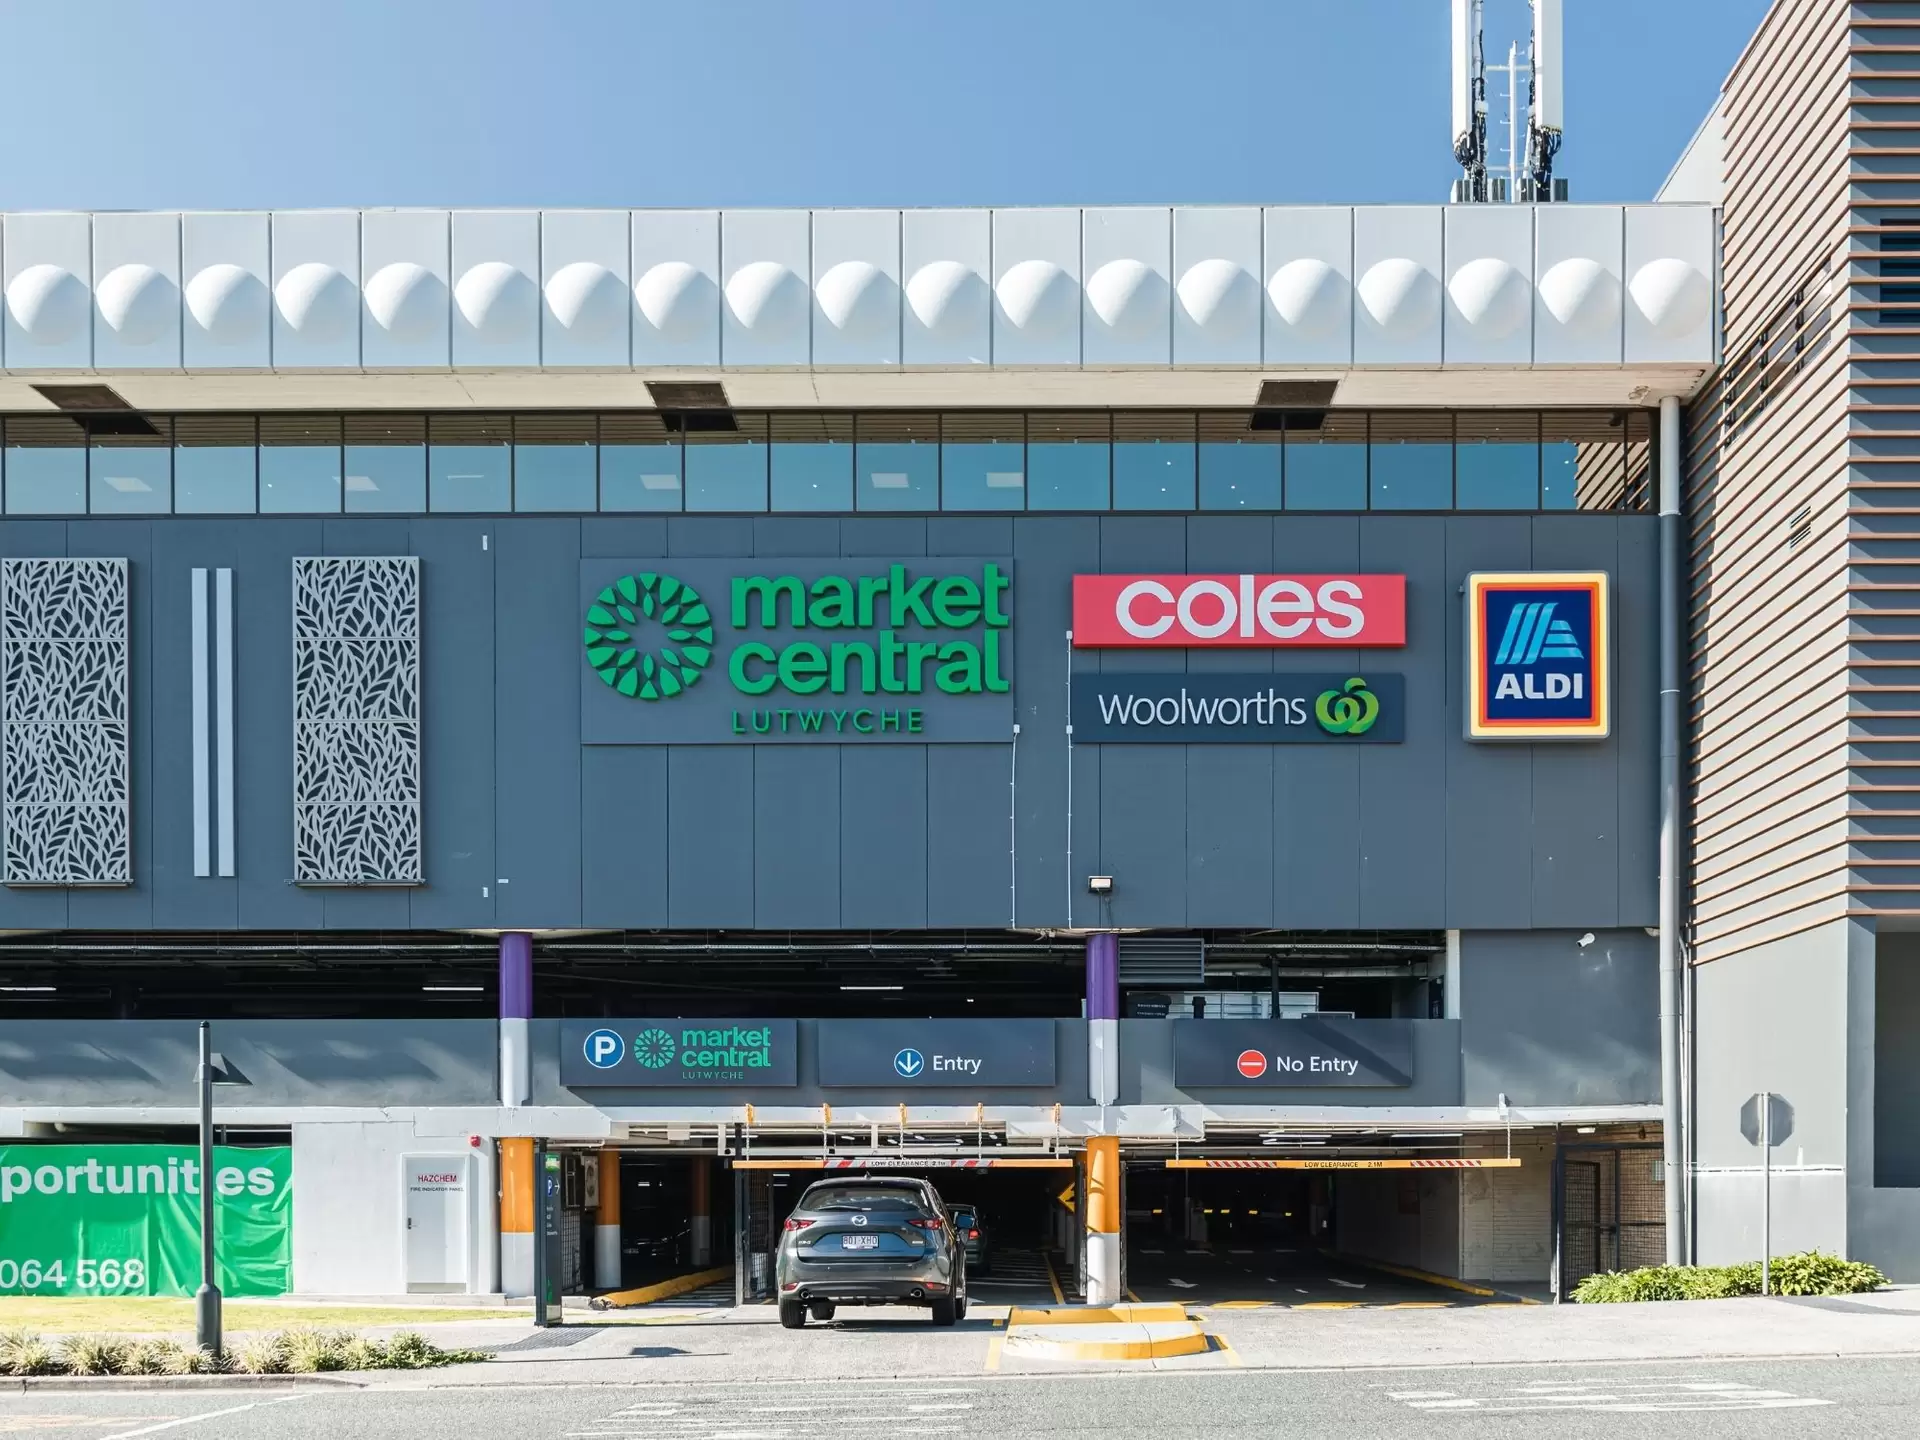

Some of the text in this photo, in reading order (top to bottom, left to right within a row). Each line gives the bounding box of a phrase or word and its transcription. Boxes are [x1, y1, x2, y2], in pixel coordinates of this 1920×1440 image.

[731, 563, 1010, 629] market
[1115, 574, 1365, 639] coles
[728, 629, 1010, 695] central
[1494, 673, 1584, 700] ALDI
[1098, 688, 1308, 725] Woolworths
[731, 709, 924, 735] LUTWYCHE
[595, 1036, 616, 1063] P
[681, 1026, 772, 1047] market
[680, 1047, 772, 1068] central
[932, 1055, 982, 1075] Entry
[1276, 1056, 1359, 1076] No Entry
[682, 1071, 744, 1080] LUTWYCHE
[1, 1157, 275, 1203] portunites
[417, 1174, 457, 1183] HAZCHEM
[0, 1258, 146, 1290] 064 568
